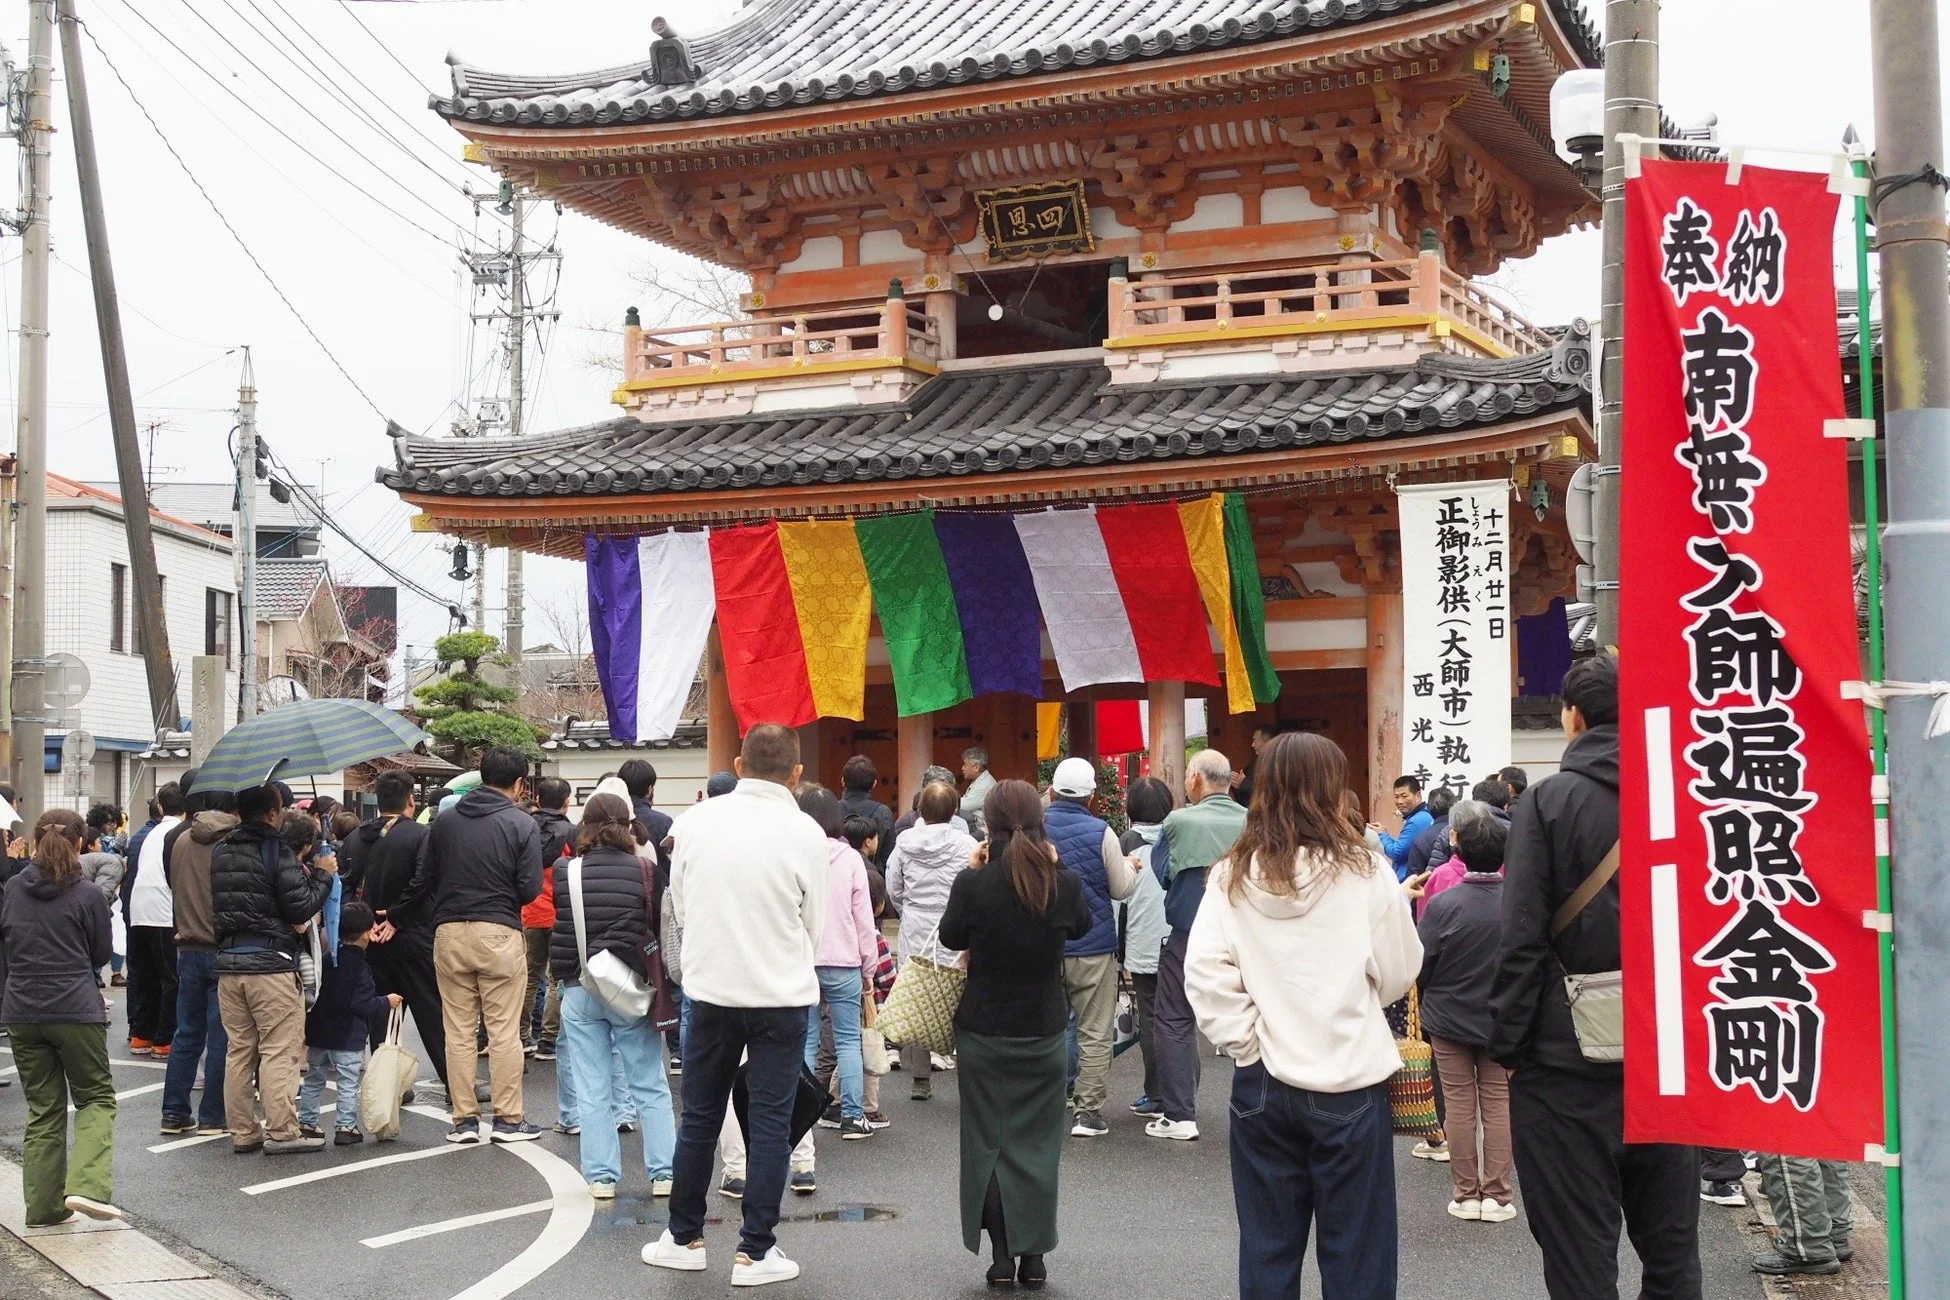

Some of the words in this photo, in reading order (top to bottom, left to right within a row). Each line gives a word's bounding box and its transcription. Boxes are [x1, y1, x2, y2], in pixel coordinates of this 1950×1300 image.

[1483, 508, 1505, 639] 十二月廿一日
[1411, 672, 1435, 791] 西光寺
